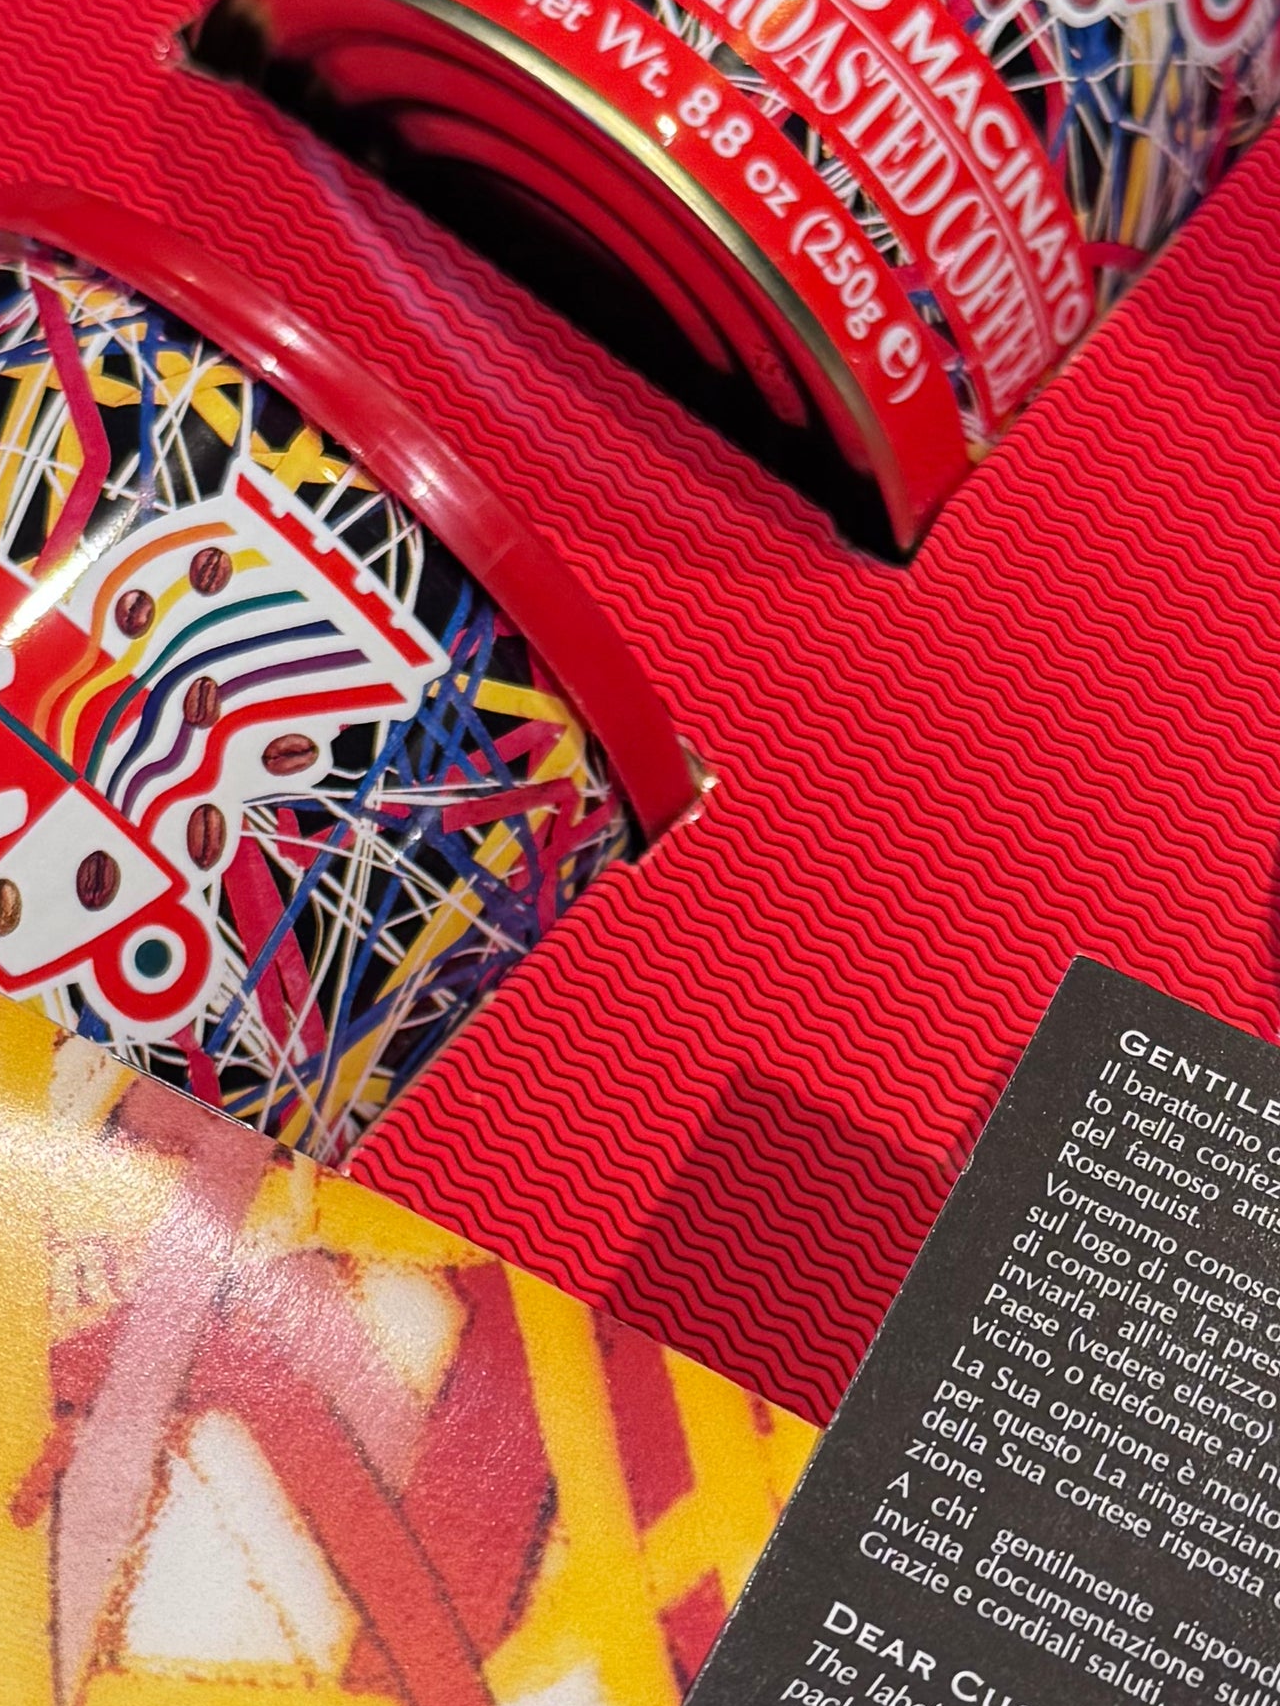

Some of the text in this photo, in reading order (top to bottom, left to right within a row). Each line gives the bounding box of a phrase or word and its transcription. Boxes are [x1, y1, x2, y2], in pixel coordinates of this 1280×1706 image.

[594, 14, 670, 98] Wt.
[678, 86, 754, 161] 8.8
[745, 159, 799, 219] oz
[790, 212, 883, 340] (250g
[893, 10, 1092, 345] MACINATO
[925, 189, 1049, 416] COFFEE
[1070, 1116, 1116, 1149] del
[1125, 1140, 1220, 1201] famoso
[1098, 1059, 1121, 1084] Il
[1122, 1069, 1261, 1152] barattolino
[1057, 1140, 1200, 1228] Rosenquist.
[998, 1254, 1096, 1320] inviarla
[1117, 1320, 1276, 1409] all'indirizzo
[904, 1438, 985, 1493] zione.
[932, 1380, 981, 1413] per
[992, 1408, 1081, 1464] questo
[1092, 1452, 1127, 1489] La
[885, 1470, 909, 1499] A
[930, 1495, 978, 1530] chi
[990, 1529, 1153, 1622] gentilmente
[921, 1406, 987, 1454] della
[995, 1442, 1046, 1485] Sua
[1054, 1478, 1151, 1538] cortese
[1158, 1530, 1264, 1597] risposta
[823, 1600, 936, 1680] DEAR
[858, 1530, 949, 1593] Grazie
[952, 1584, 973, 1606] e
[976, 1597, 1084, 1662] cordiali
[872, 1498, 963, 1563] inviata
[975, 1556, 1204, 1687] documentazione
[805, 1639, 858, 1685] The
